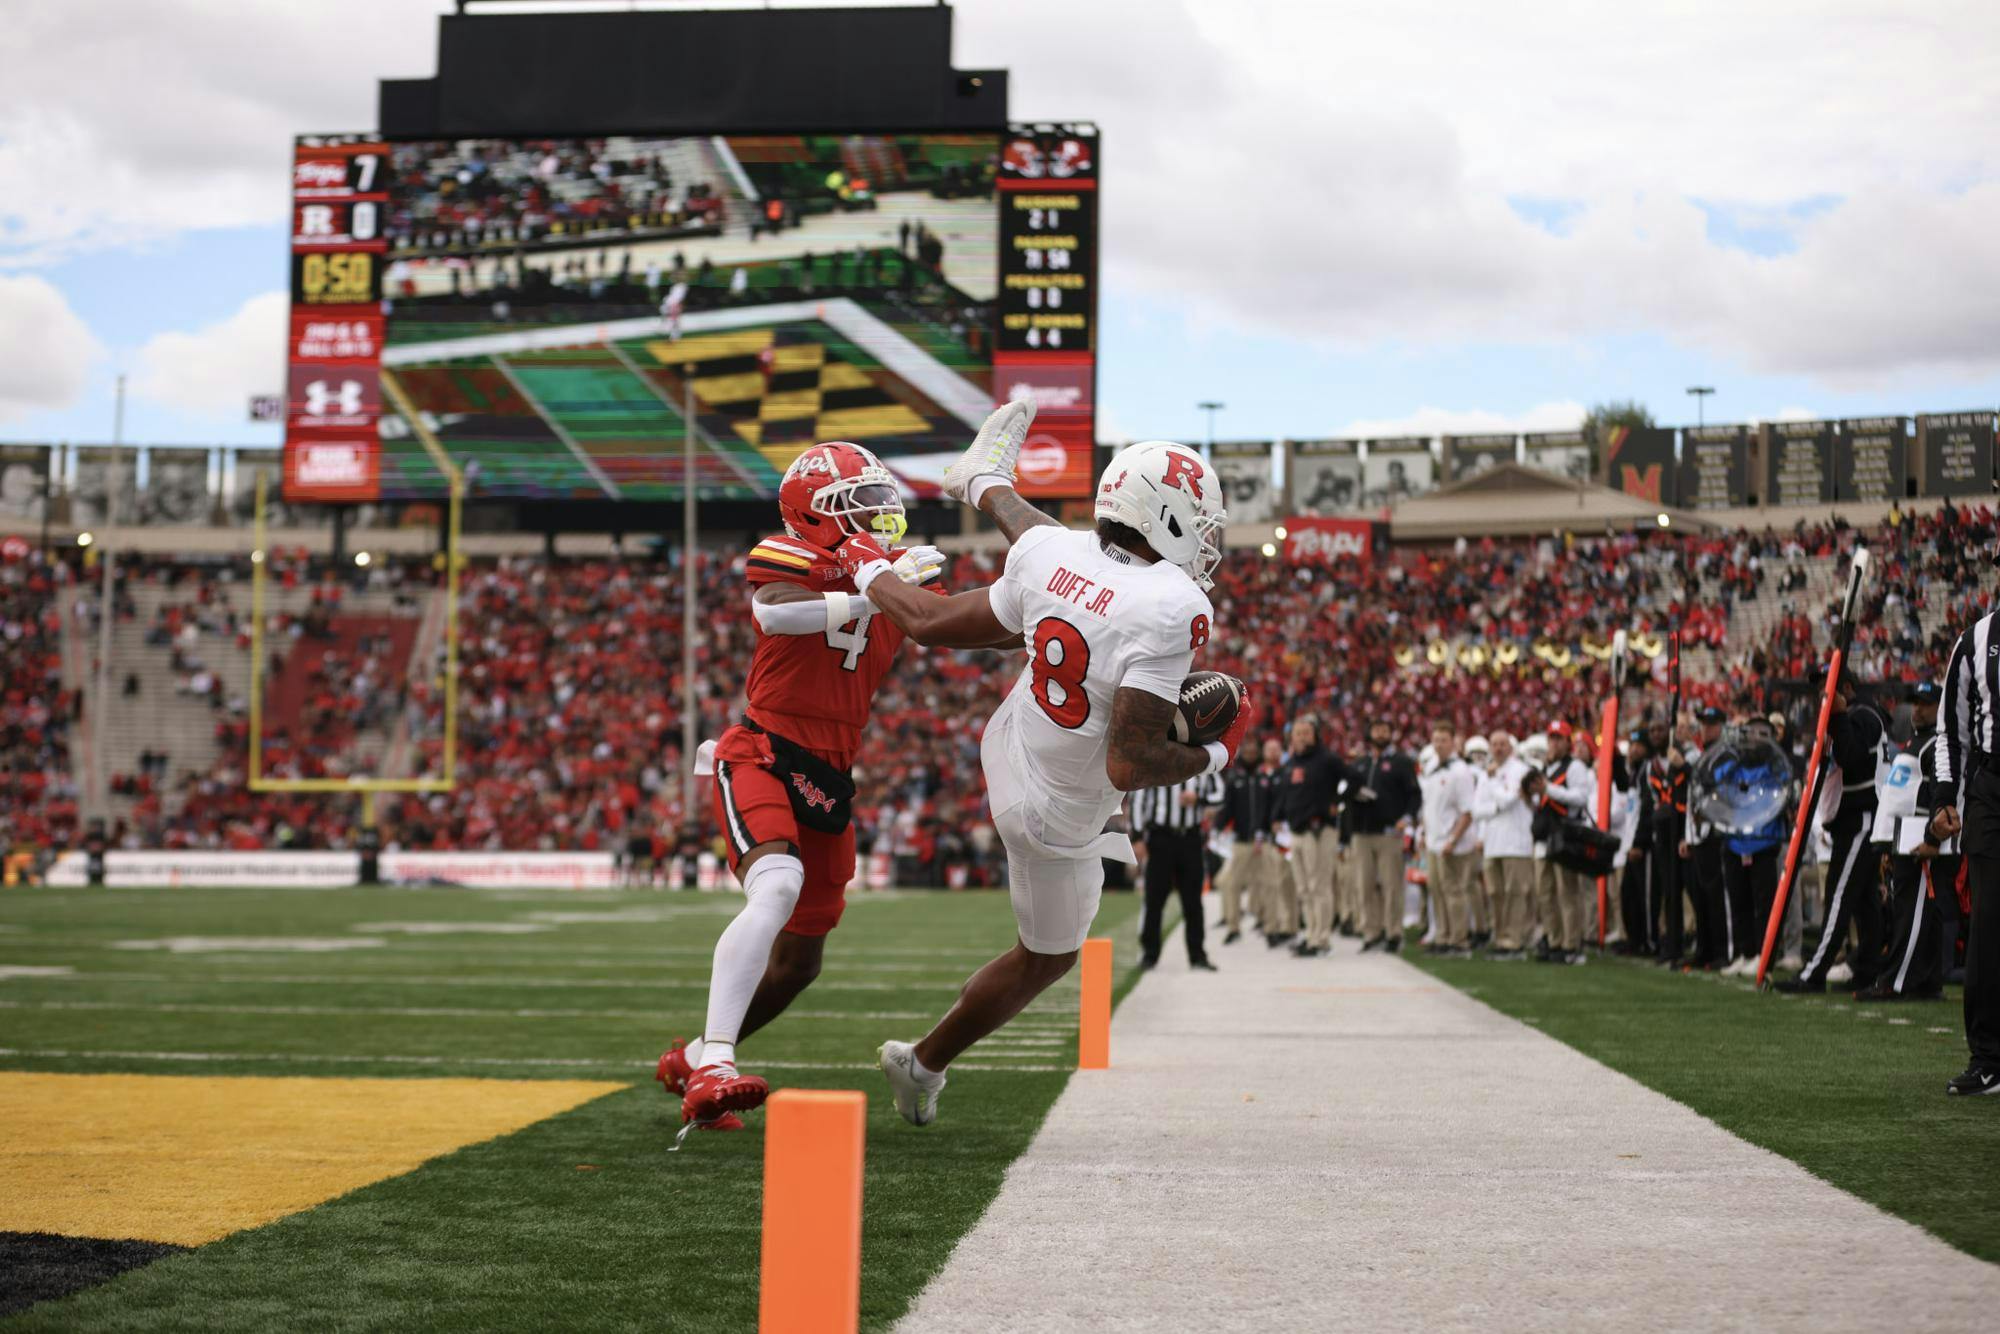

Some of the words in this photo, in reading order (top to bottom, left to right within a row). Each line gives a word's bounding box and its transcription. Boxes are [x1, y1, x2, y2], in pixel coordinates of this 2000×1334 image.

[355, 154, 378, 192] 7
[302, 205, 333, 234] R
[352, 202, 376, 239] 0
[1161, 450, 1204, 500] R
[1622, 463, 1663, 505] M
[1046, 566, 1095, 604] DUFF
[1085, 587, 1115, 617] JR.
[824, 612, 872, 673] 4
[1190, 613, 1210, 650] 8
[1989, 644, 2000, 657] S
[1031, 616, 1091, 730] 8
